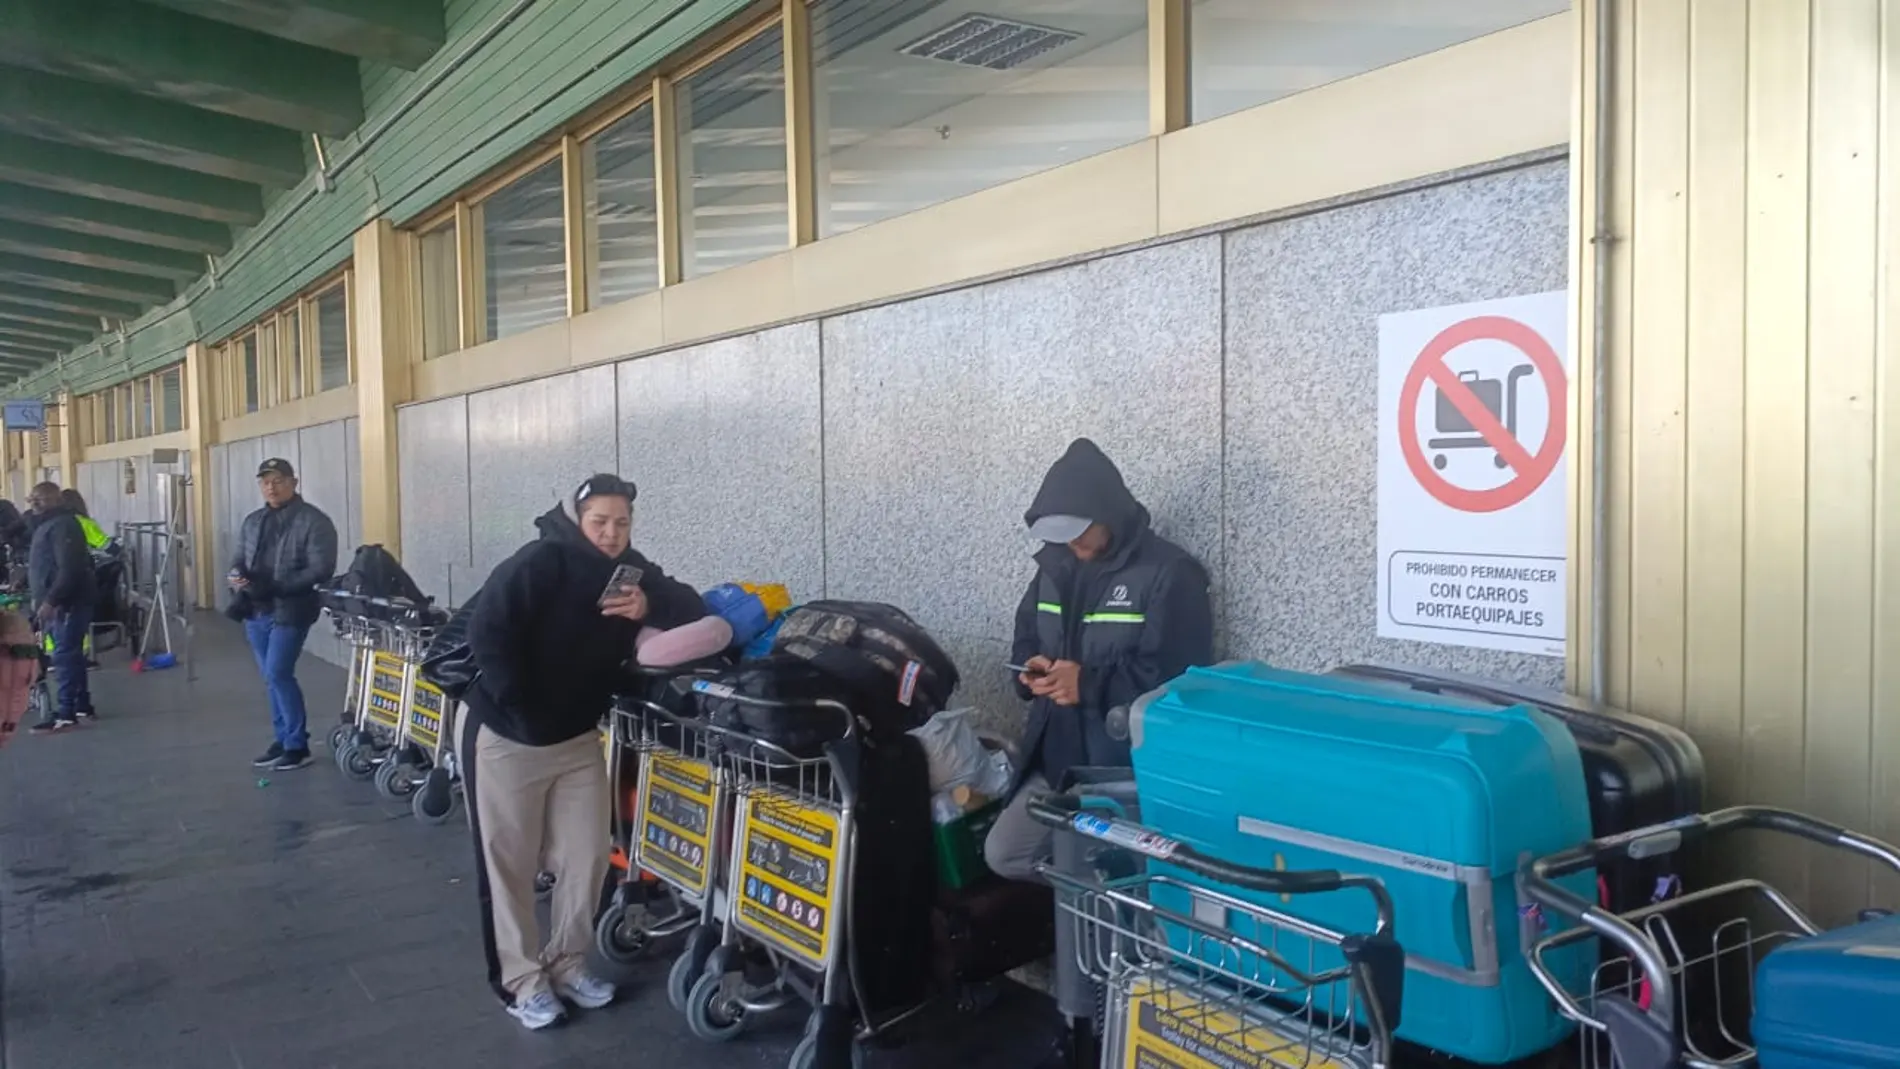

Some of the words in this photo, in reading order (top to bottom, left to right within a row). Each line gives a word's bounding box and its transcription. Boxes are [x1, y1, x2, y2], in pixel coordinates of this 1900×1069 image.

[1406, 562, 1467, 577] PROHIBIDO
[1471, 565, 1556, 582] PERMANECER
[1430, 582, 1461, 598] CON
[1466, 585, 1528, 603] CARROS
[1416, 602, 1544, 626] PORTAEQUIPAJES
